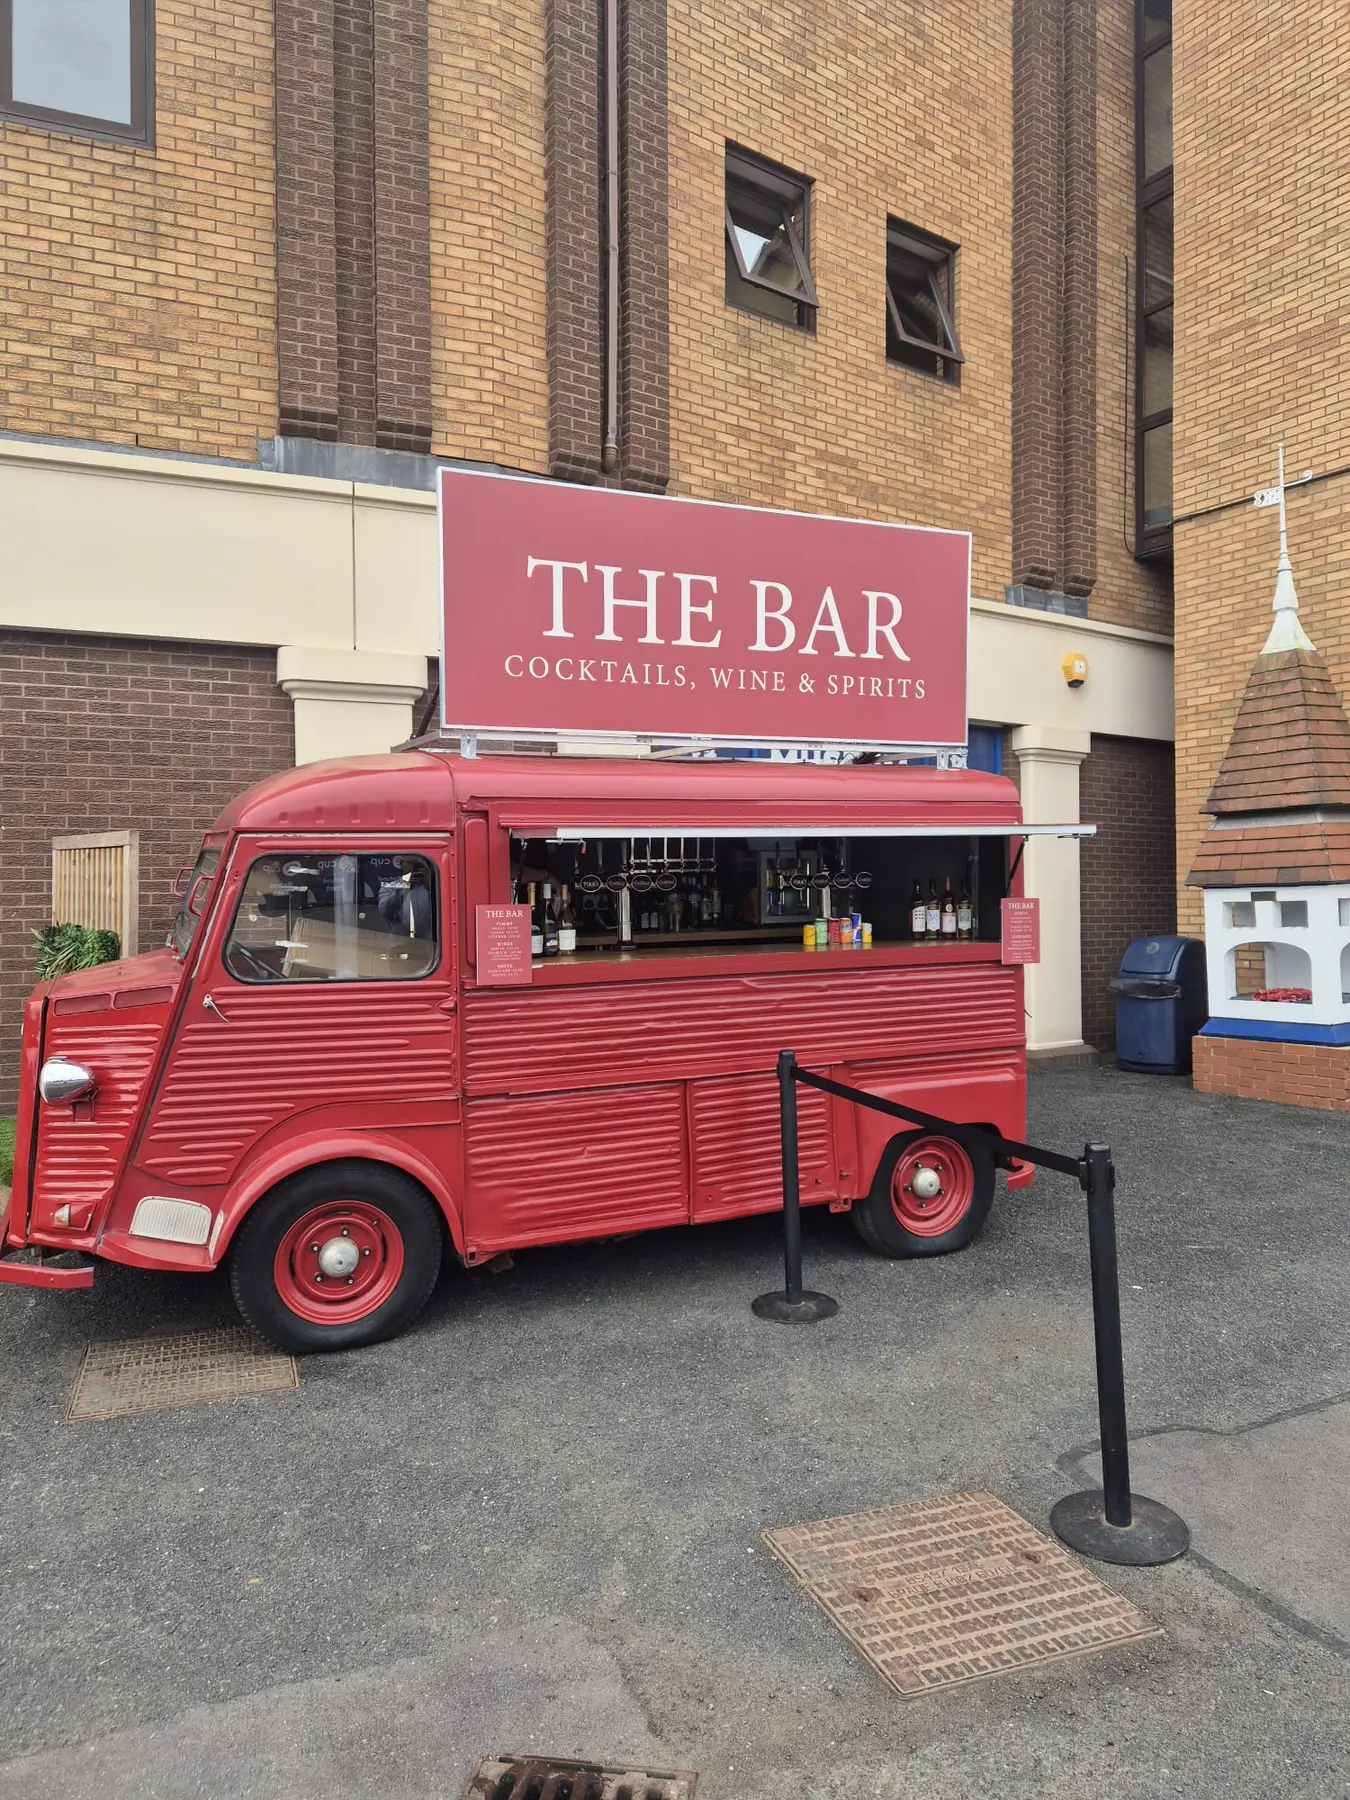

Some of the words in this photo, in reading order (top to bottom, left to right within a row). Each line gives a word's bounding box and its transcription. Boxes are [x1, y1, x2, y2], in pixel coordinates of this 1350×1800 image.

[527, 555, 722, 648] THE
[748, 579, 911, 662] BAR
[504, 654, 697, 691] COCKTAILS,
[709, 667, 786, 692] WINE
[798, 672, 815, 693] &
[827, 674, 926, 699] SPIRITS
[485, 910, 504, 918] THE
[506, 909, 524, 918] BAR
